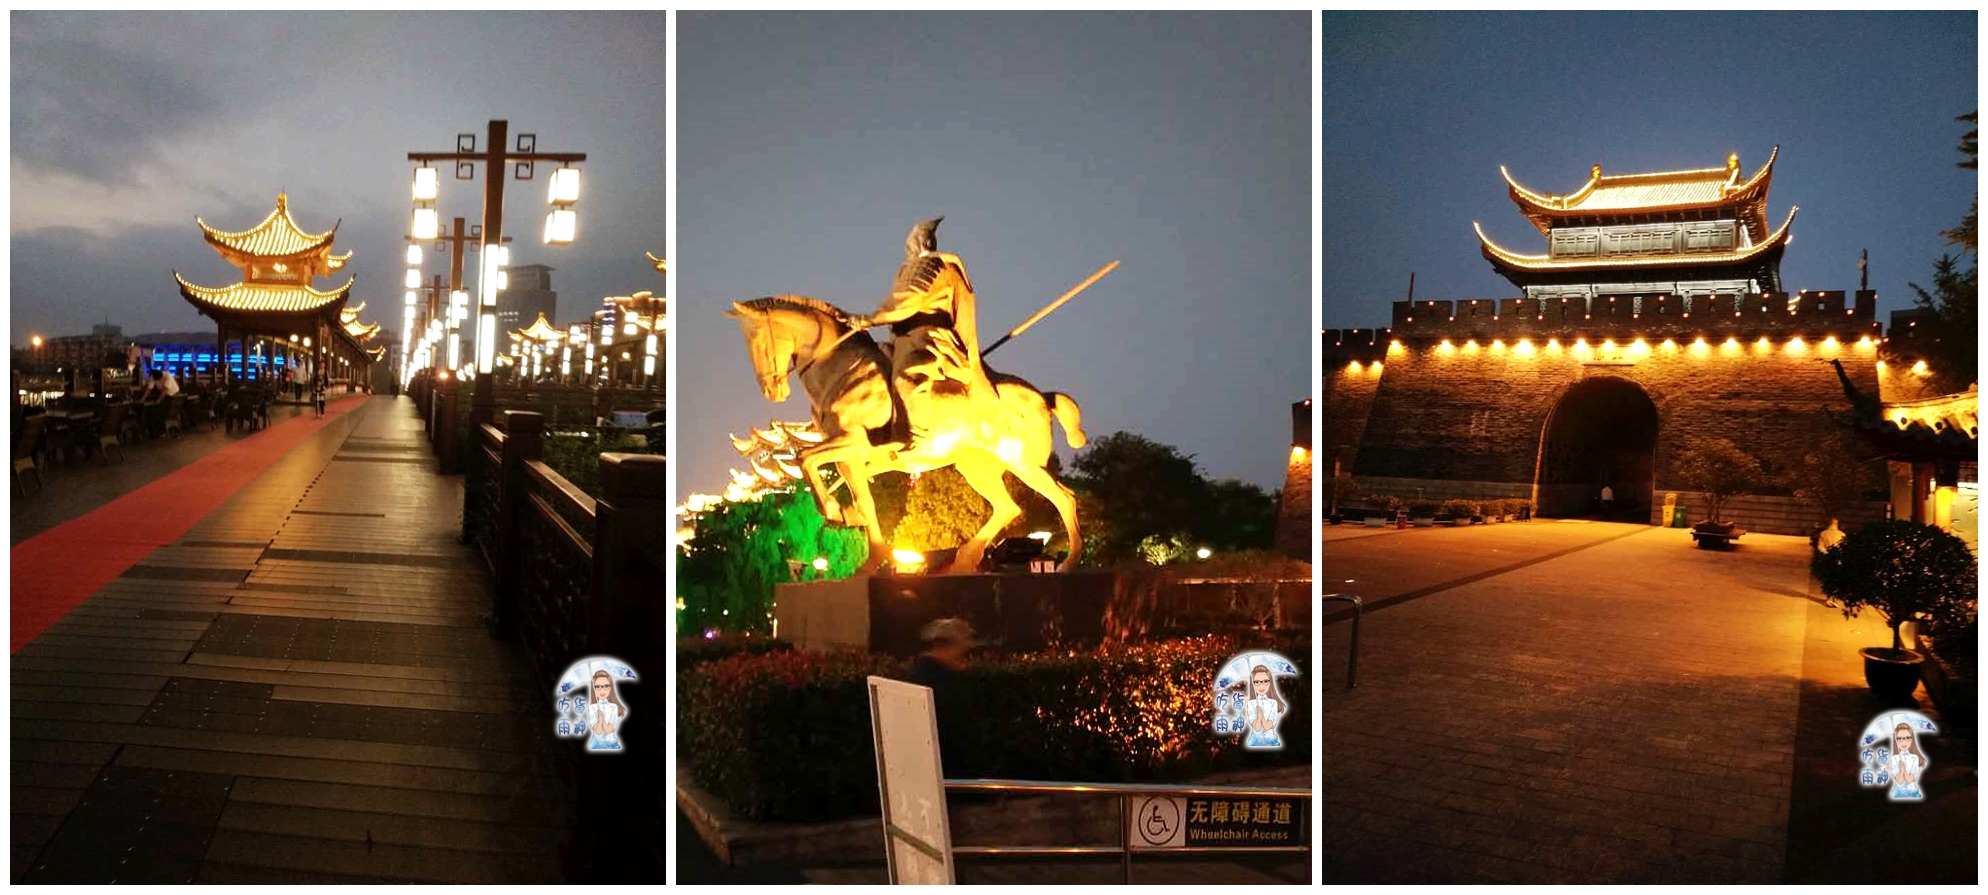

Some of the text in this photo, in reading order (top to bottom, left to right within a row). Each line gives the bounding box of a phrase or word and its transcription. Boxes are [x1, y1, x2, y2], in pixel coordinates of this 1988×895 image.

[1190, 801, 1291, 824] 无障碍通道
[1190, 829, 1288, 840] Wheelchair Access
